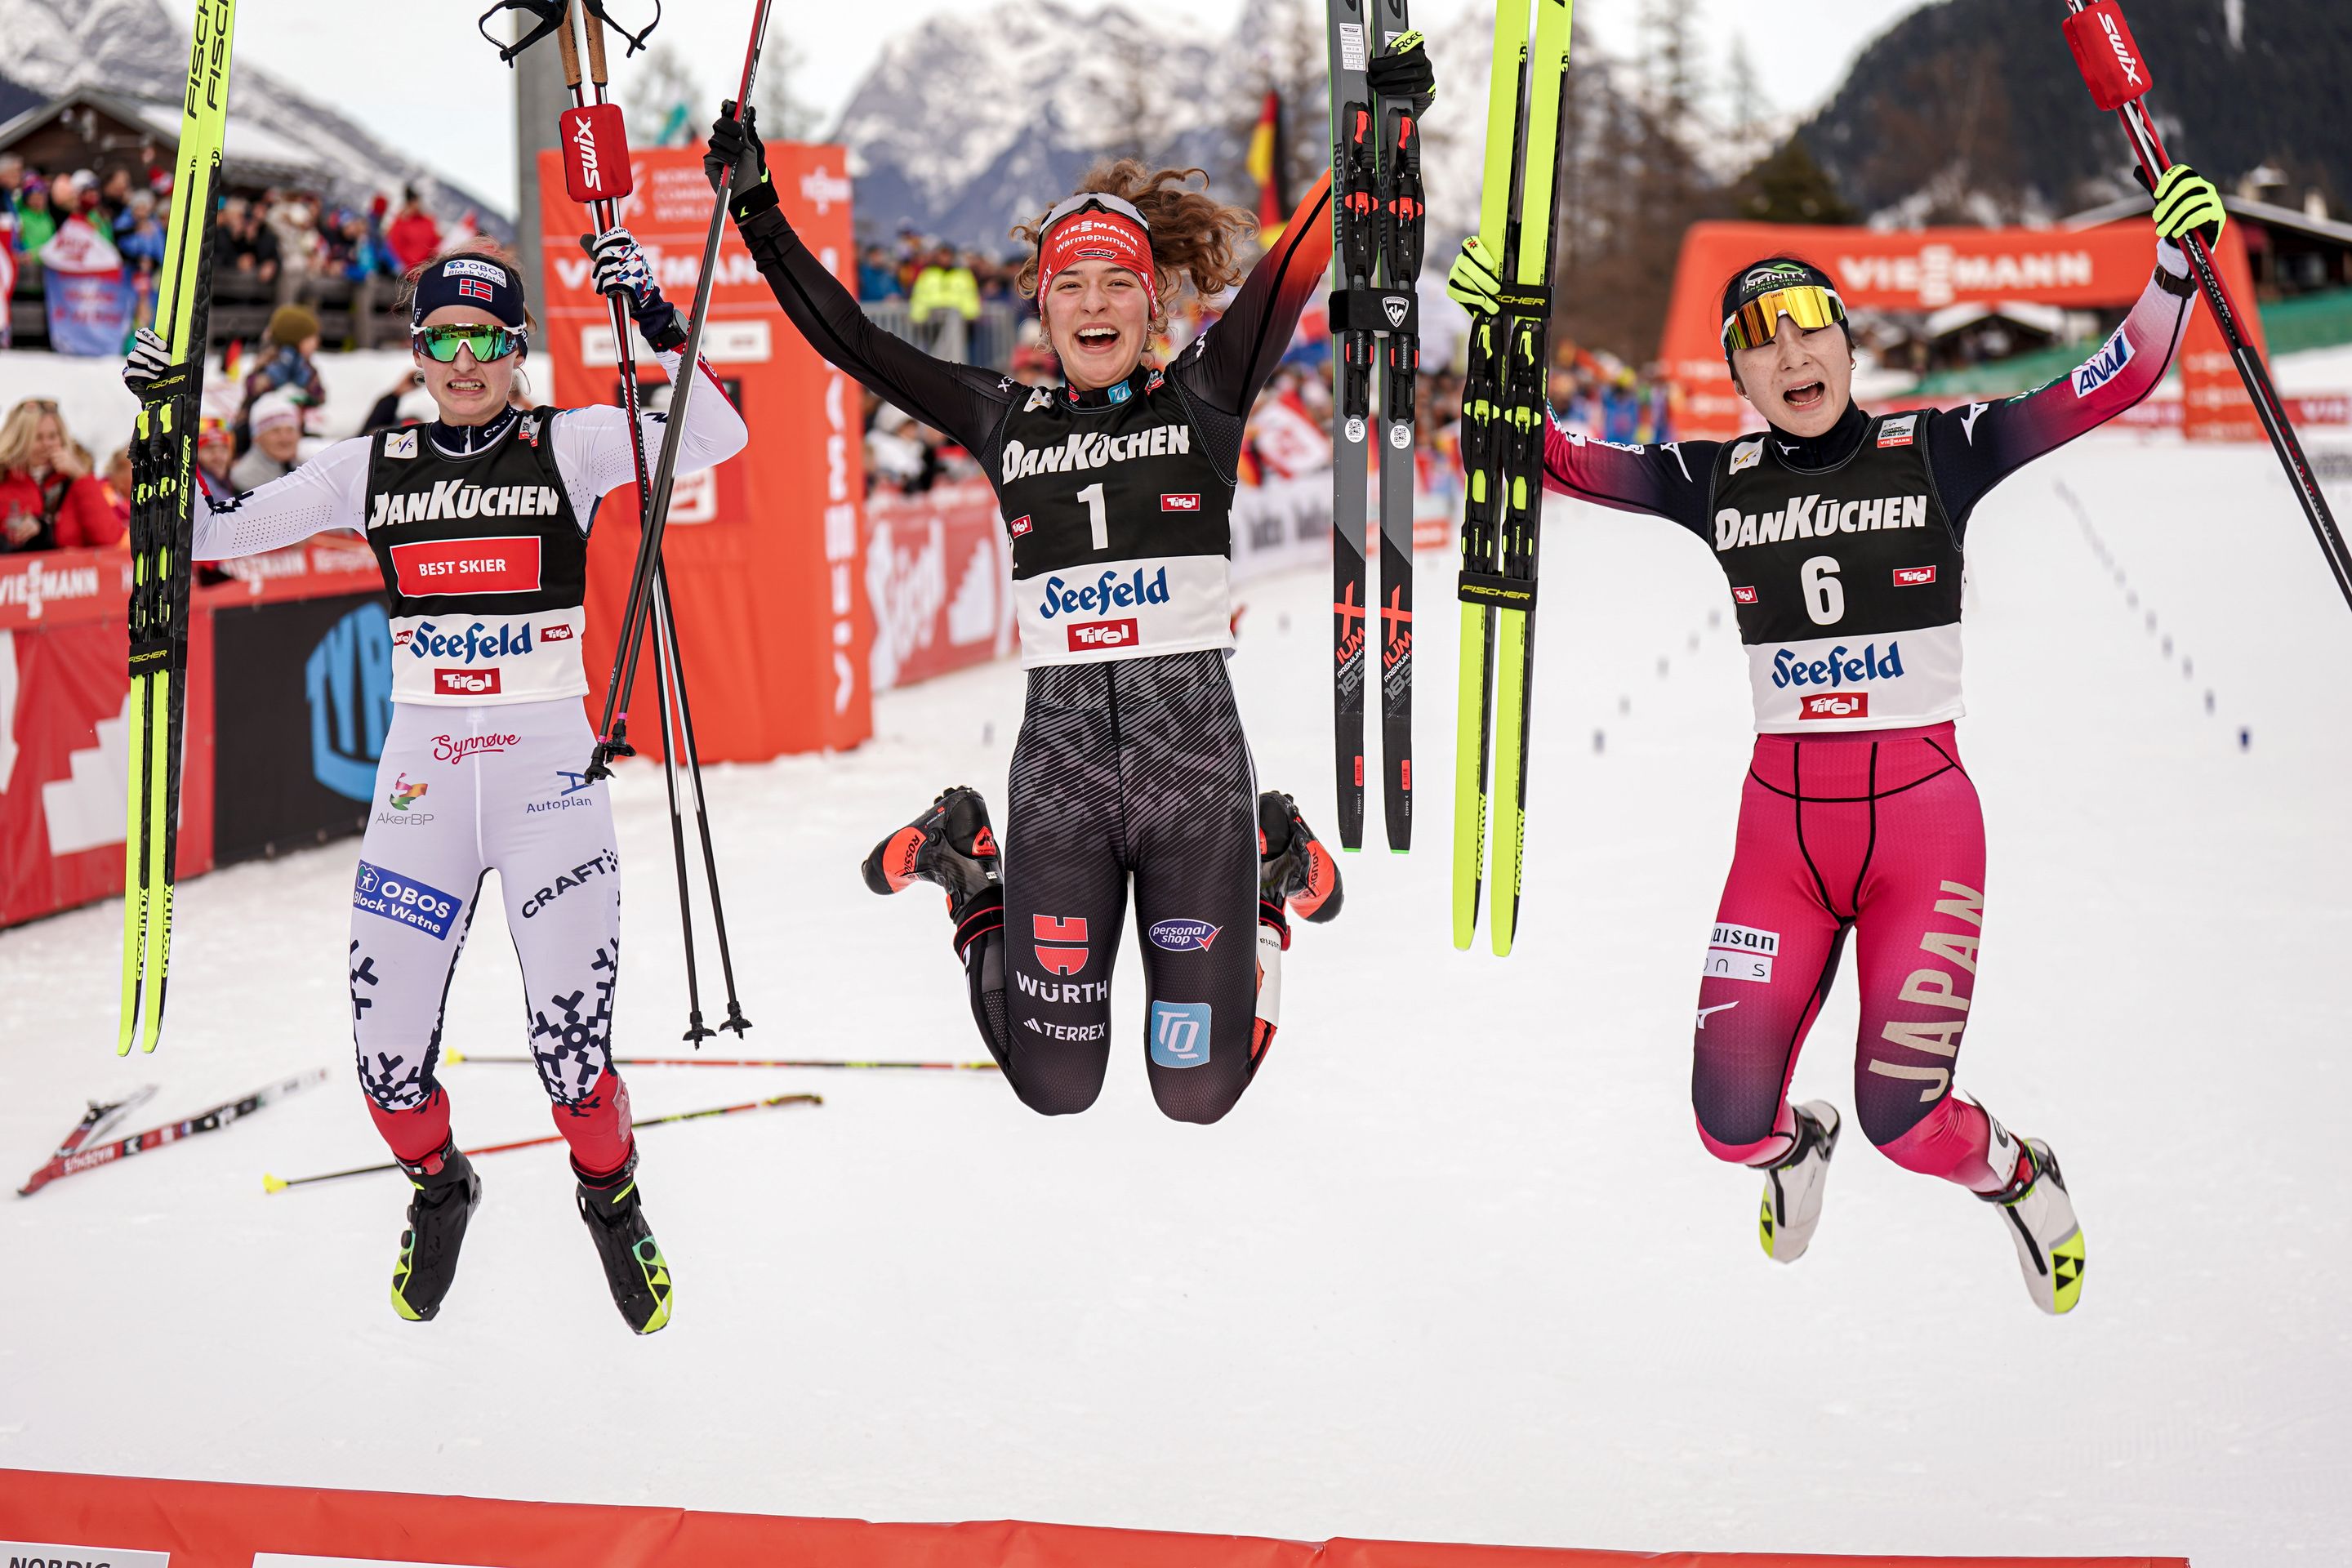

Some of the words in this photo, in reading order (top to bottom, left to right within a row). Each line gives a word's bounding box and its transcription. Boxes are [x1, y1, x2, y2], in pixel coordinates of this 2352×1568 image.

[207, 0, 229, 111] FISC
[1055, 220, 1138, 246] VIESSMANN
[1056, 234, 1137, 257] Wärmepumpen
[469, 263, 505, 279] OBOS
[478, 271, 506, 287] Watne
[1742, 273, 1806, 292] INFINITY
[1838, 244, 2093, 305] VIESSMANN
[146, 375, 185, 390] FISCHER
[2079, 352, 2118, 394] ANA
[179, 434, 192, 520] FISCHER
[1167, 497, 1196, 509] Tirol
[1076, 483, 1108, 550] 1
[418, 562, 455, 577] BEST
[459, 559, 506, 573] SKIER
[1899, 570, 1931, 583] Tirol
[1040, 566, 1169, 619] Seefeld
[1461, 585, 1530, 600] FISCHER
[1800, 555, 1845, 625] 6
[410, 621, 532, 664] Seefeld
[546, 625, 570, 639] Tirol
[1075, 625, 1129, 646] Tirol
[1771, 641, 1904, 689] Seefeld
[442, 674, 492, 692] Tirol
[1810, 697, 1860, 716] Tirol
[431, 733, 521, 765] Synnøve
[527, 798, 593, 813] Autoplan
[375, 811, 434, 826] AkerBP
[521, 856, 606, 919] CRAFT
[381, 880, 450, 919] OBOS
[354, 891, 388, 915] Block
[390, 902, 442, 934] Watne
[1153, 924, 1206, 938] personal
[1160, 933, 1190, 946] shop
[1016, 971, 1107, 1004] WÜRTH
[1869, 880, 1984, 1102] JAPAN
[1044, 1022, 1105, 1041] TERREX
[1158, 1011, 1200, 1059] TQ
